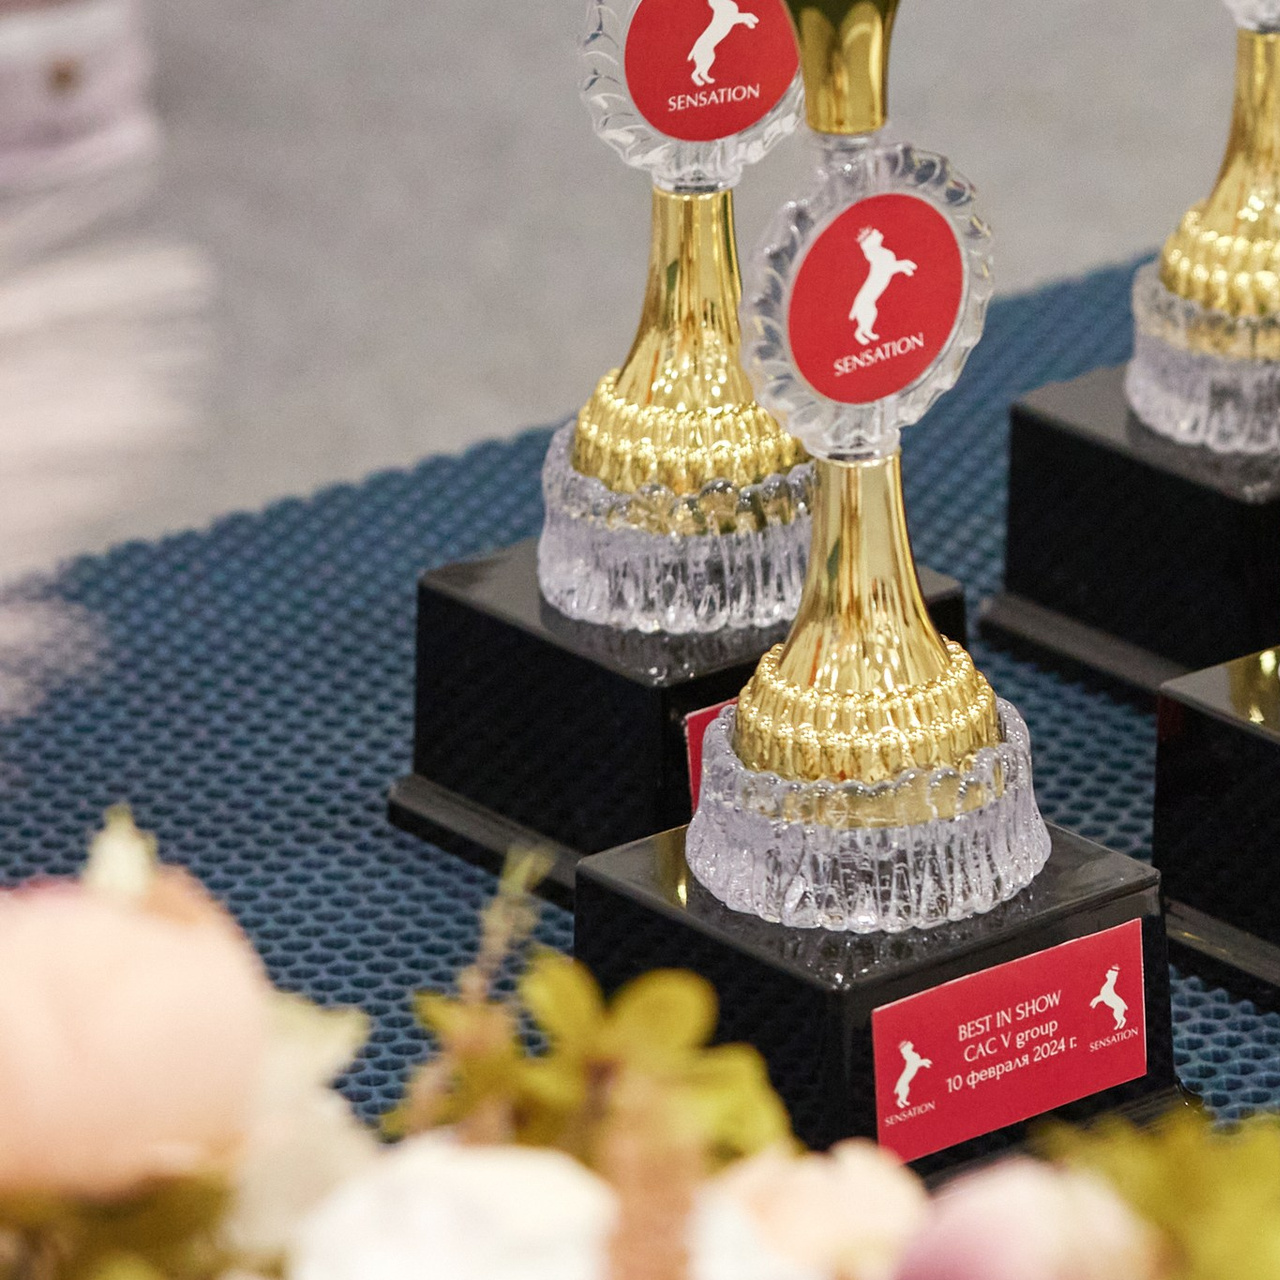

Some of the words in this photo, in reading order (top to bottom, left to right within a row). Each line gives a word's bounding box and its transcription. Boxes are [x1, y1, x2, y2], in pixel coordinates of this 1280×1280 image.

[668, 83, 760, 112] SENSATION
[833, 332, 924, 377] SENSATION
[958, 1015, 992, 1042] BEST
[996, 1008, 1012, 1029] IN
[1015, 990, 1062, 1021] SHOW
[963, 1037, 997, 1063] CAC
[1001, 1032, 1013, 1048] V
[1016, 1020, 1059, 1049] group
[1089, 1027, 1139, 1052] SENSATION
[946, 1074, 962, 1093] 10
[966, 1054, 1029, 1089] февраля
[1033, 1038, 1066, 1063] 2024
[884, 1101, 936, 1127] SENSATION
